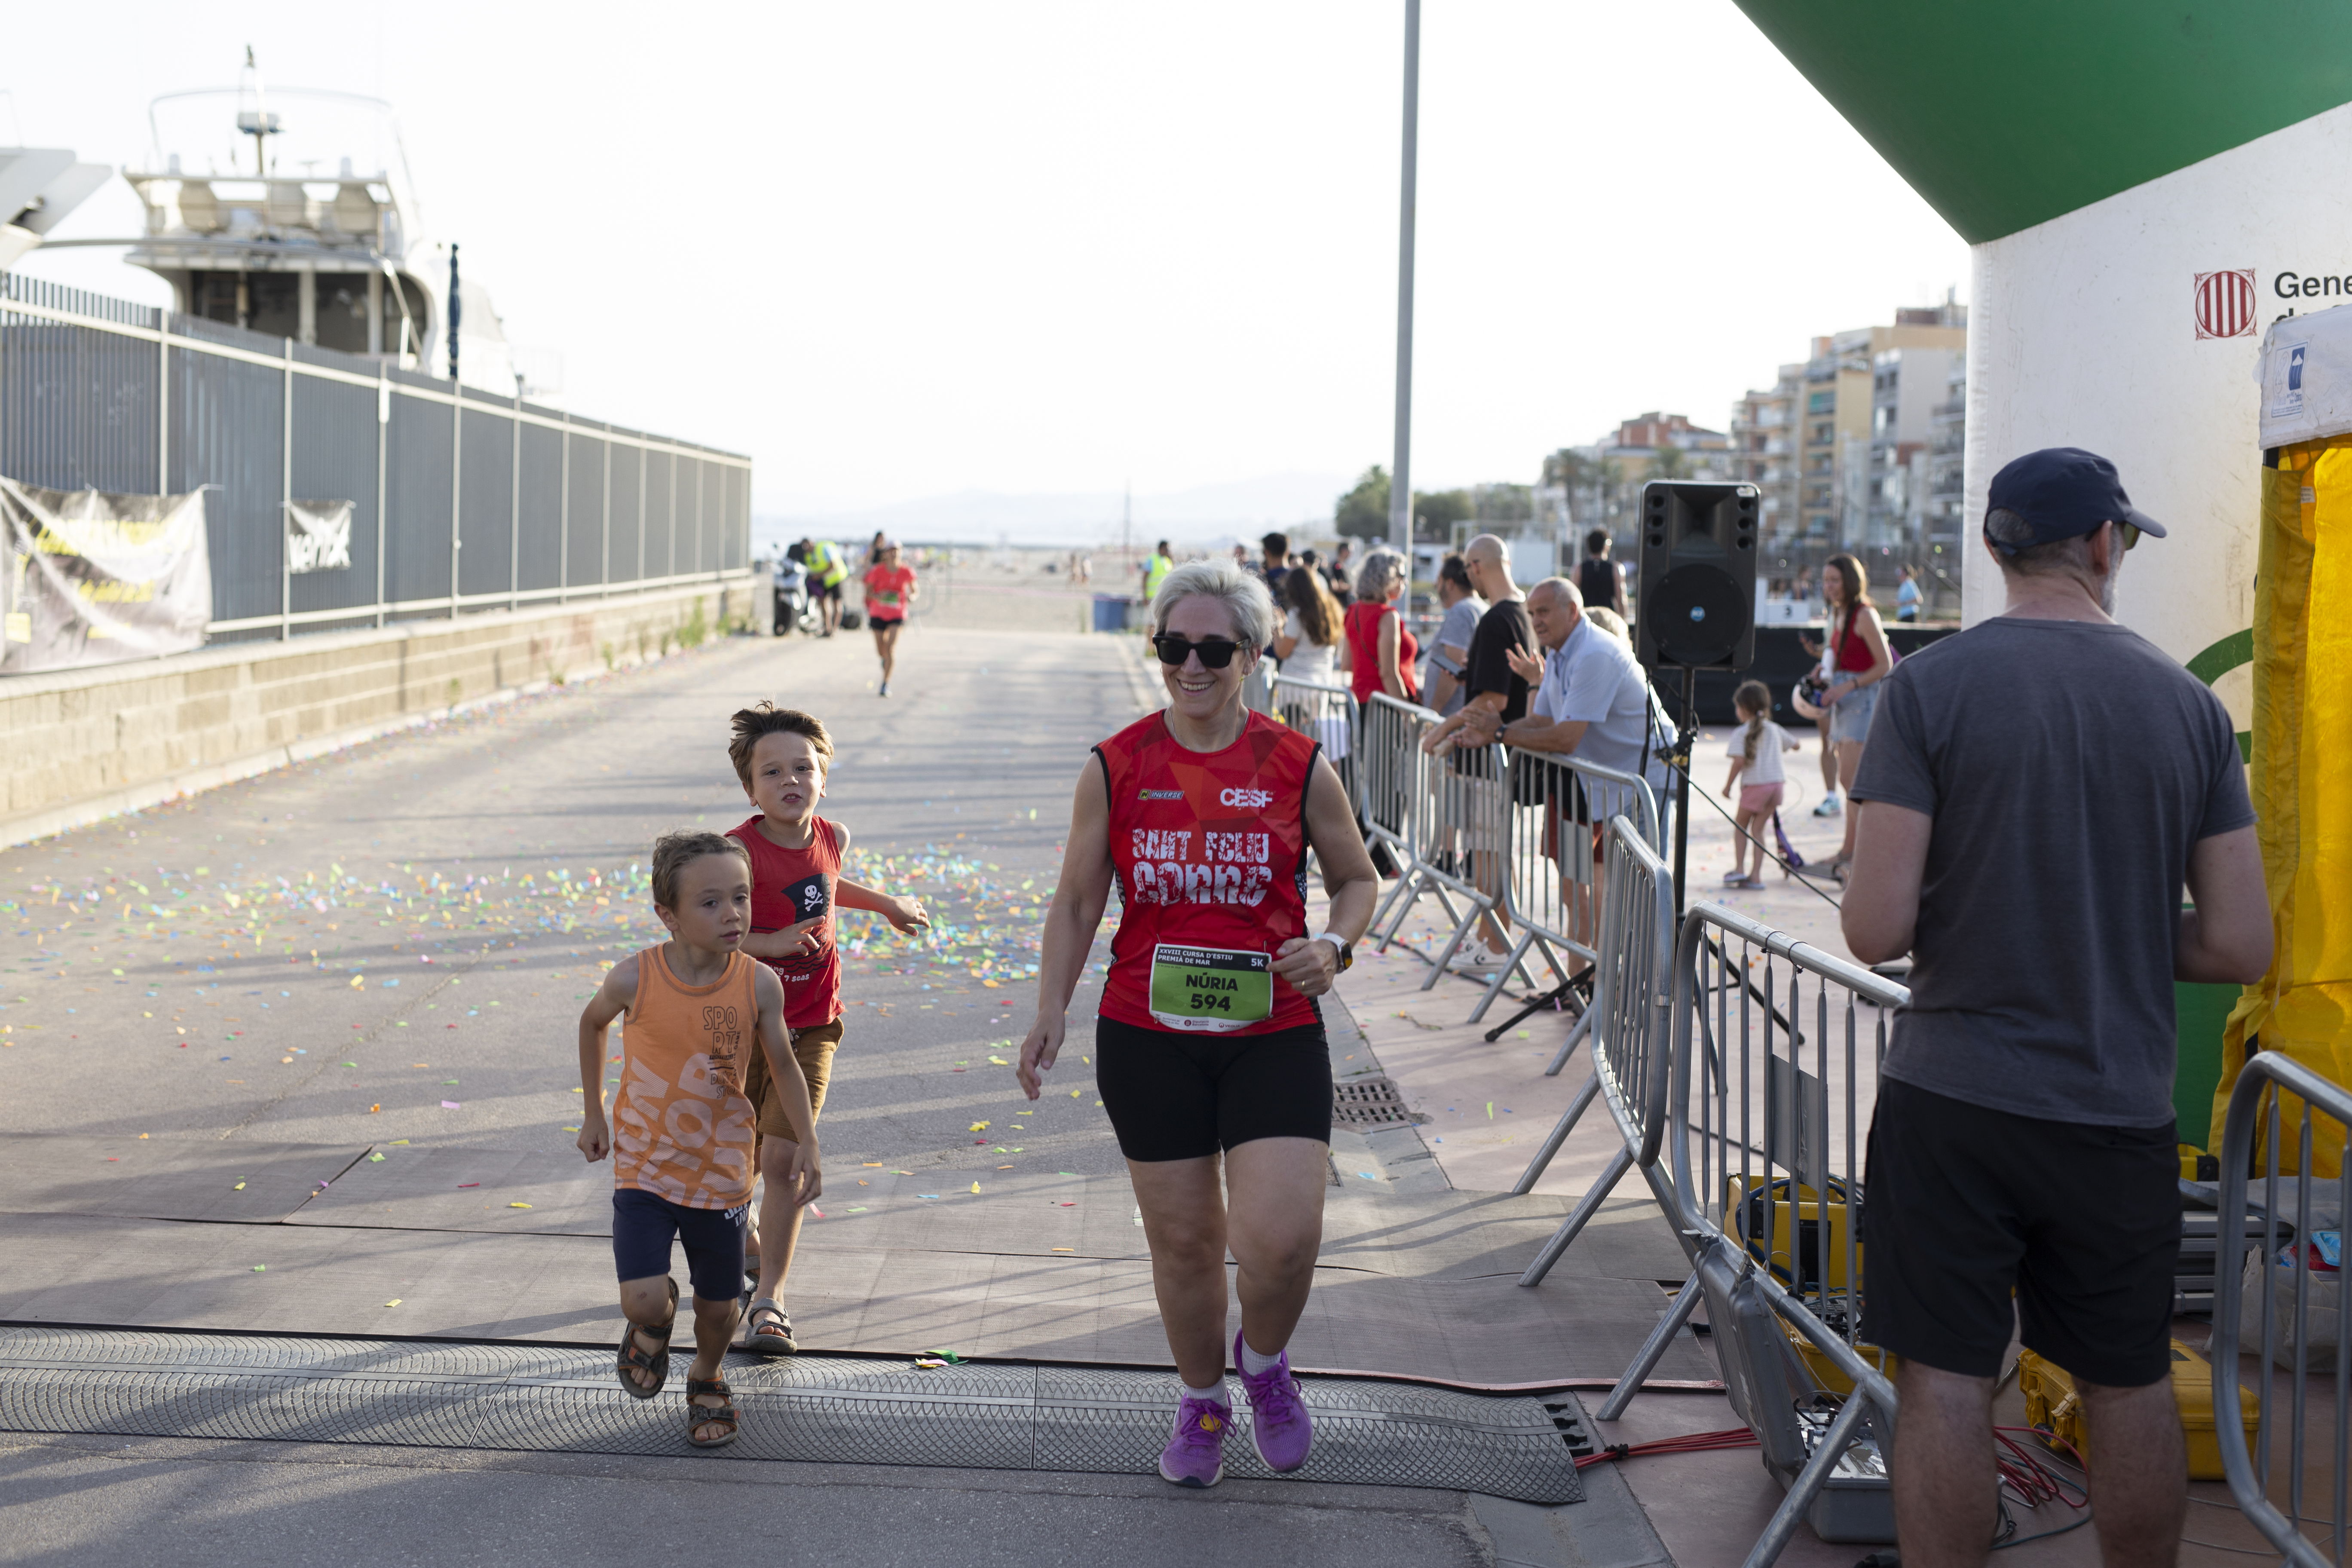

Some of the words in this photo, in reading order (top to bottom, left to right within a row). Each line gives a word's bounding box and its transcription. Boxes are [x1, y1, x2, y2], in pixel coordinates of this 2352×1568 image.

[1220, 787, 1273, 808] CESF
[1132, 828, 1191, 860] SANT
[1205, 831, 1269, 864] FELIU
[1133, 861, 1272, 907] CORRE
[1251, 958, 1264, 967] 5K
[792, 974, 809, 982] seas
[1186, 972, 1238, 991] NÚRIA
[1190, 993, 1231, 1012] 594
[703, 1006, 737, 1030] SPO
[712, 1031, 737, 1054] RT
